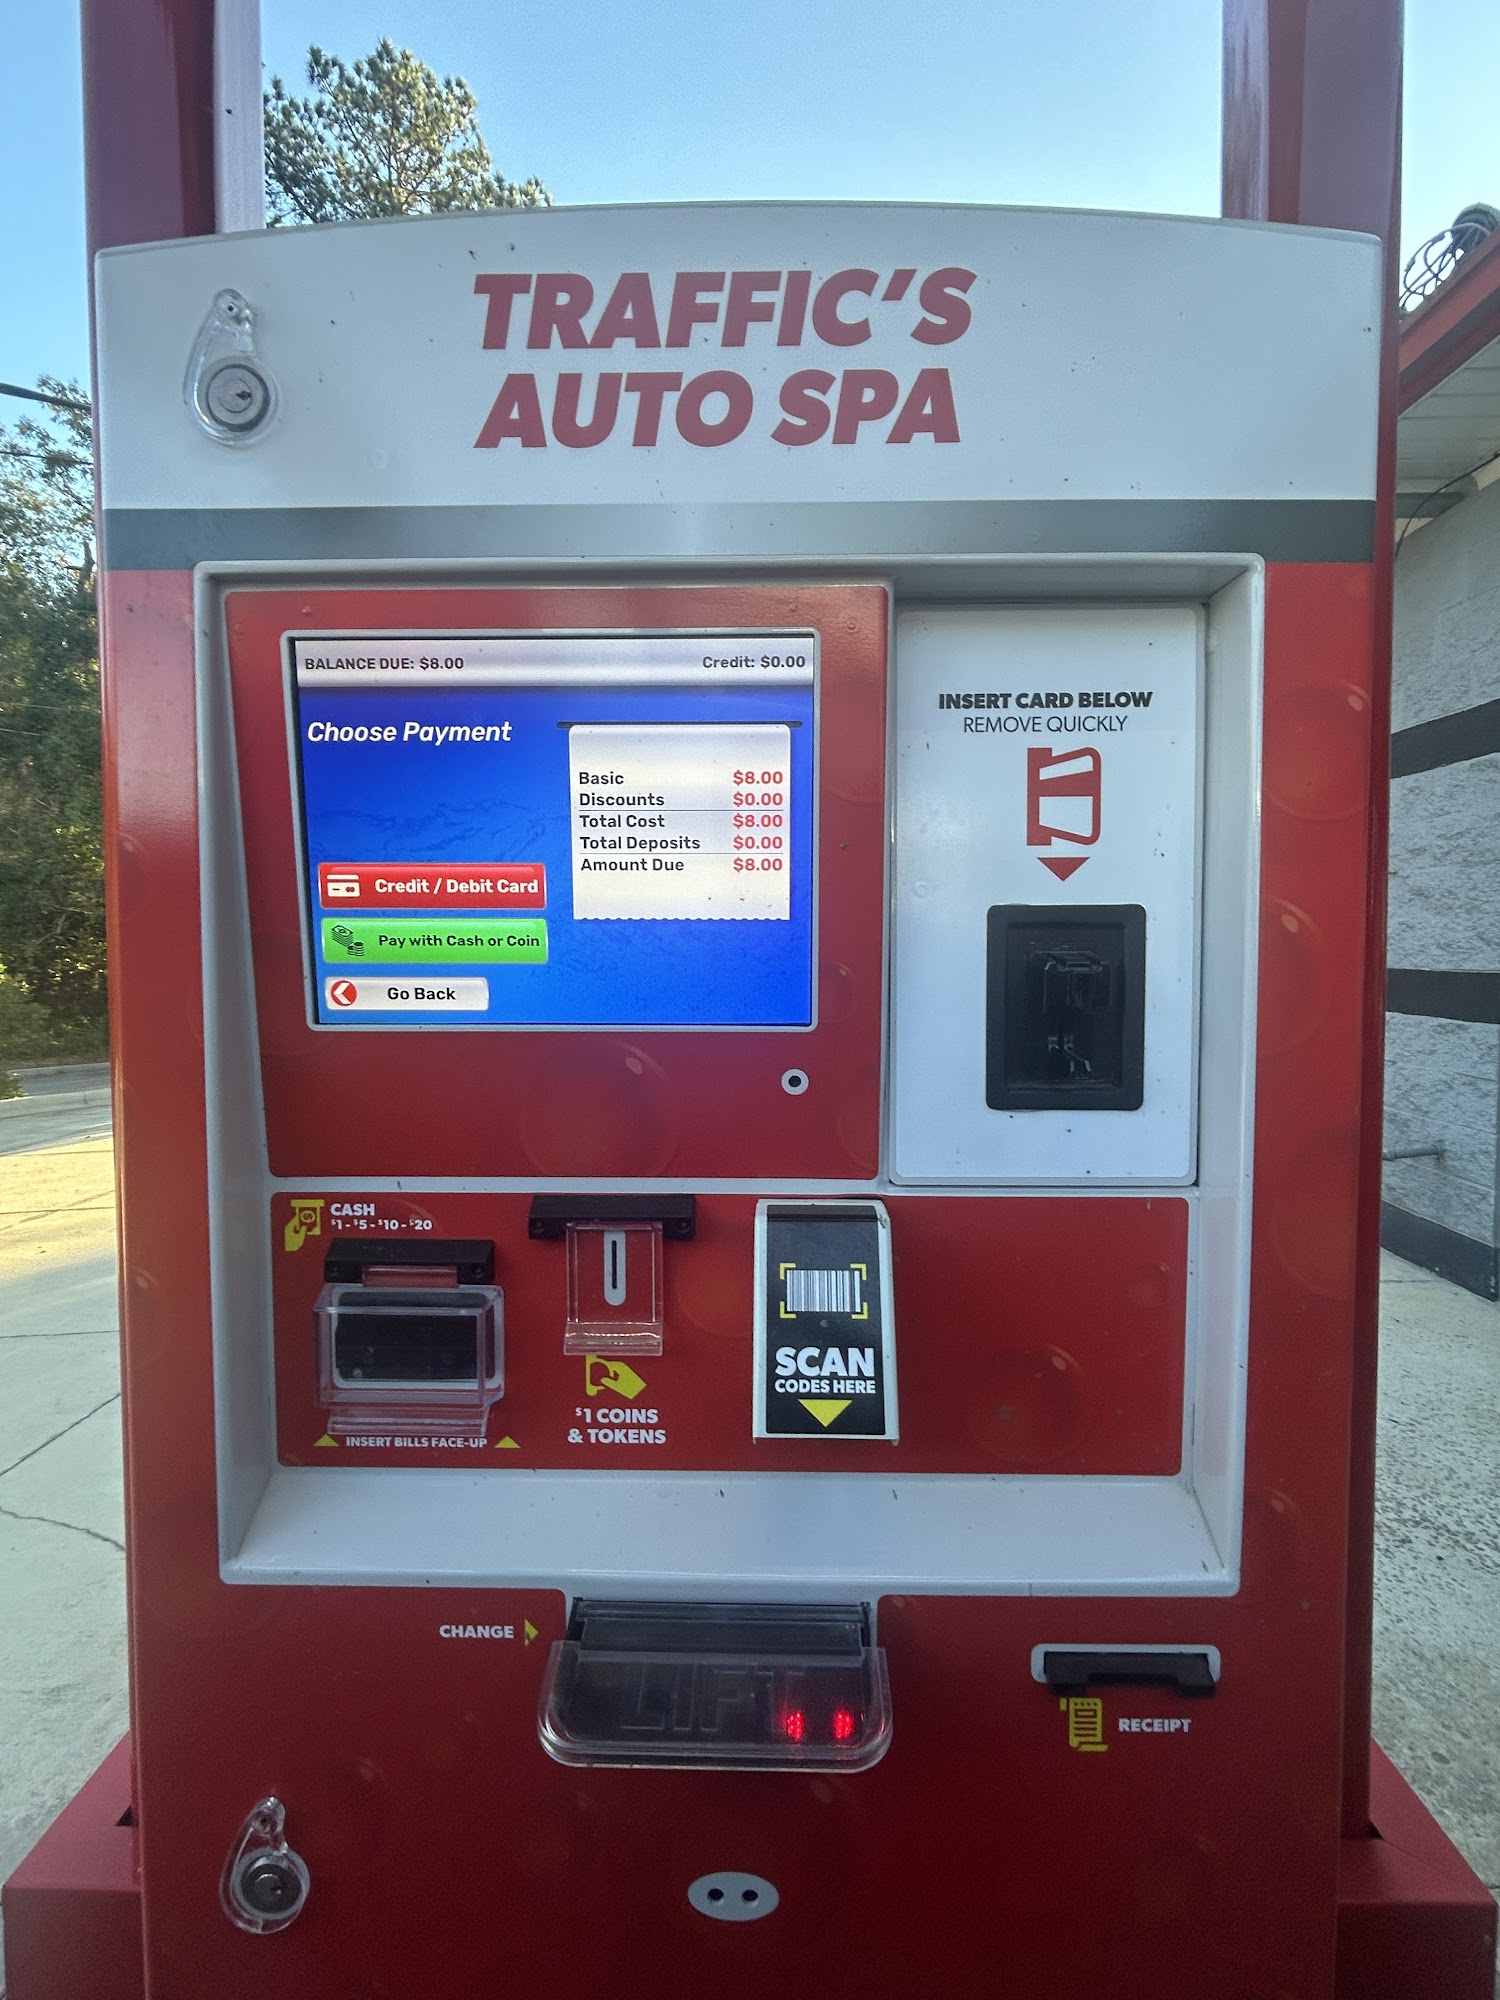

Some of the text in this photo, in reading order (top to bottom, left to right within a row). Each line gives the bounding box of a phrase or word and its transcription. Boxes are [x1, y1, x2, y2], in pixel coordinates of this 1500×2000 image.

[473, 267, 978, 350] TRAFFIC'S
[473, 367, 961, 449] AUTO SPA
[304, 656, 464, 670] BALANCE DUE: $8.00
[702, 655, 806, 669] Credit: $0.00
[938, 691, 1154, 710] INSERT CARD BELOW
[963, 715, 1128, 733] REMOVE QUICKLY
[307, 720, 513, 746] Choose Payment
[578, 770, 783, 786] Basic $8.00
[579, 791, 783, 807] Discounts $0.00
[579, 813, 783, 828] Total Cost $8.00
[579, 835, 783, 852] Total Deposits $0.00
[580, 857, 783, 872] Amount Due $8.00
[374, 878, 539, 894] Credit / Debit Card
[378, 934, 541, 949] Pay with Cash or Coin
[387, 986, 456, 1000] Go Back
[330, 1203, 375, 1216] CASH
[775, 1346, 875, 1377] SCAN
[774, 1379, 876, 1394] CODES HERE
[575, 1407, 659, 1424] $1 COINS
[345, 1436, 488, 1448] INSERT BILLS FACE-UP
[567, 1428, 667, 1444] & TOKENS
[439, 1624, 515, 1639] CHANGE
[620, 1662, 805, 1733] LIFT
[1118, 1718, 1192, 1733] RECEIPT
